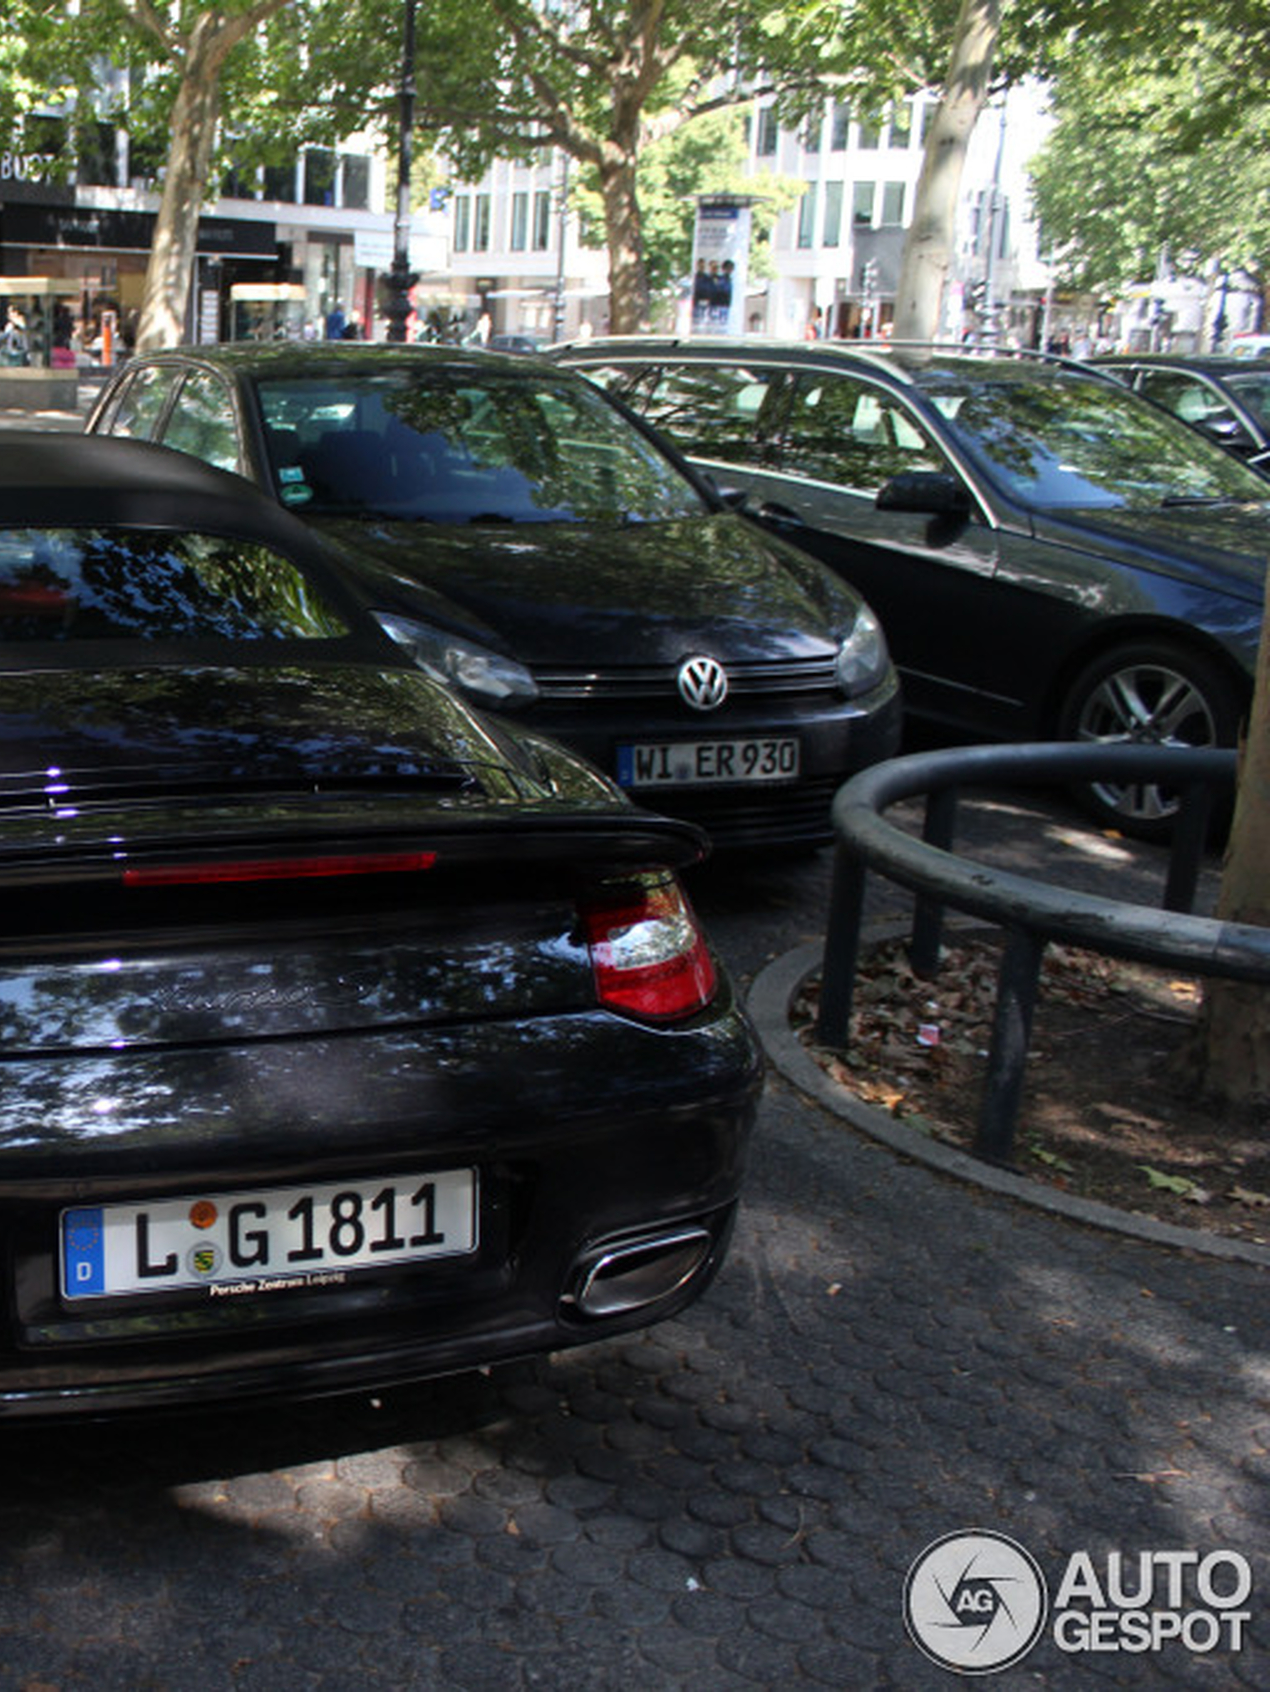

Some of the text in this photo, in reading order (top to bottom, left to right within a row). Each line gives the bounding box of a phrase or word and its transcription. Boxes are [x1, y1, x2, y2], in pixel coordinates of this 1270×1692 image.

[636, 746, 672, 781] WI
[742, 741, 795, 775] 930
[287, 1182, 445, 1263] 1811
[76, 1261, 91, 1281] D
[210, 1272, 346, 1297] Porsche Zentrum Leipzig
